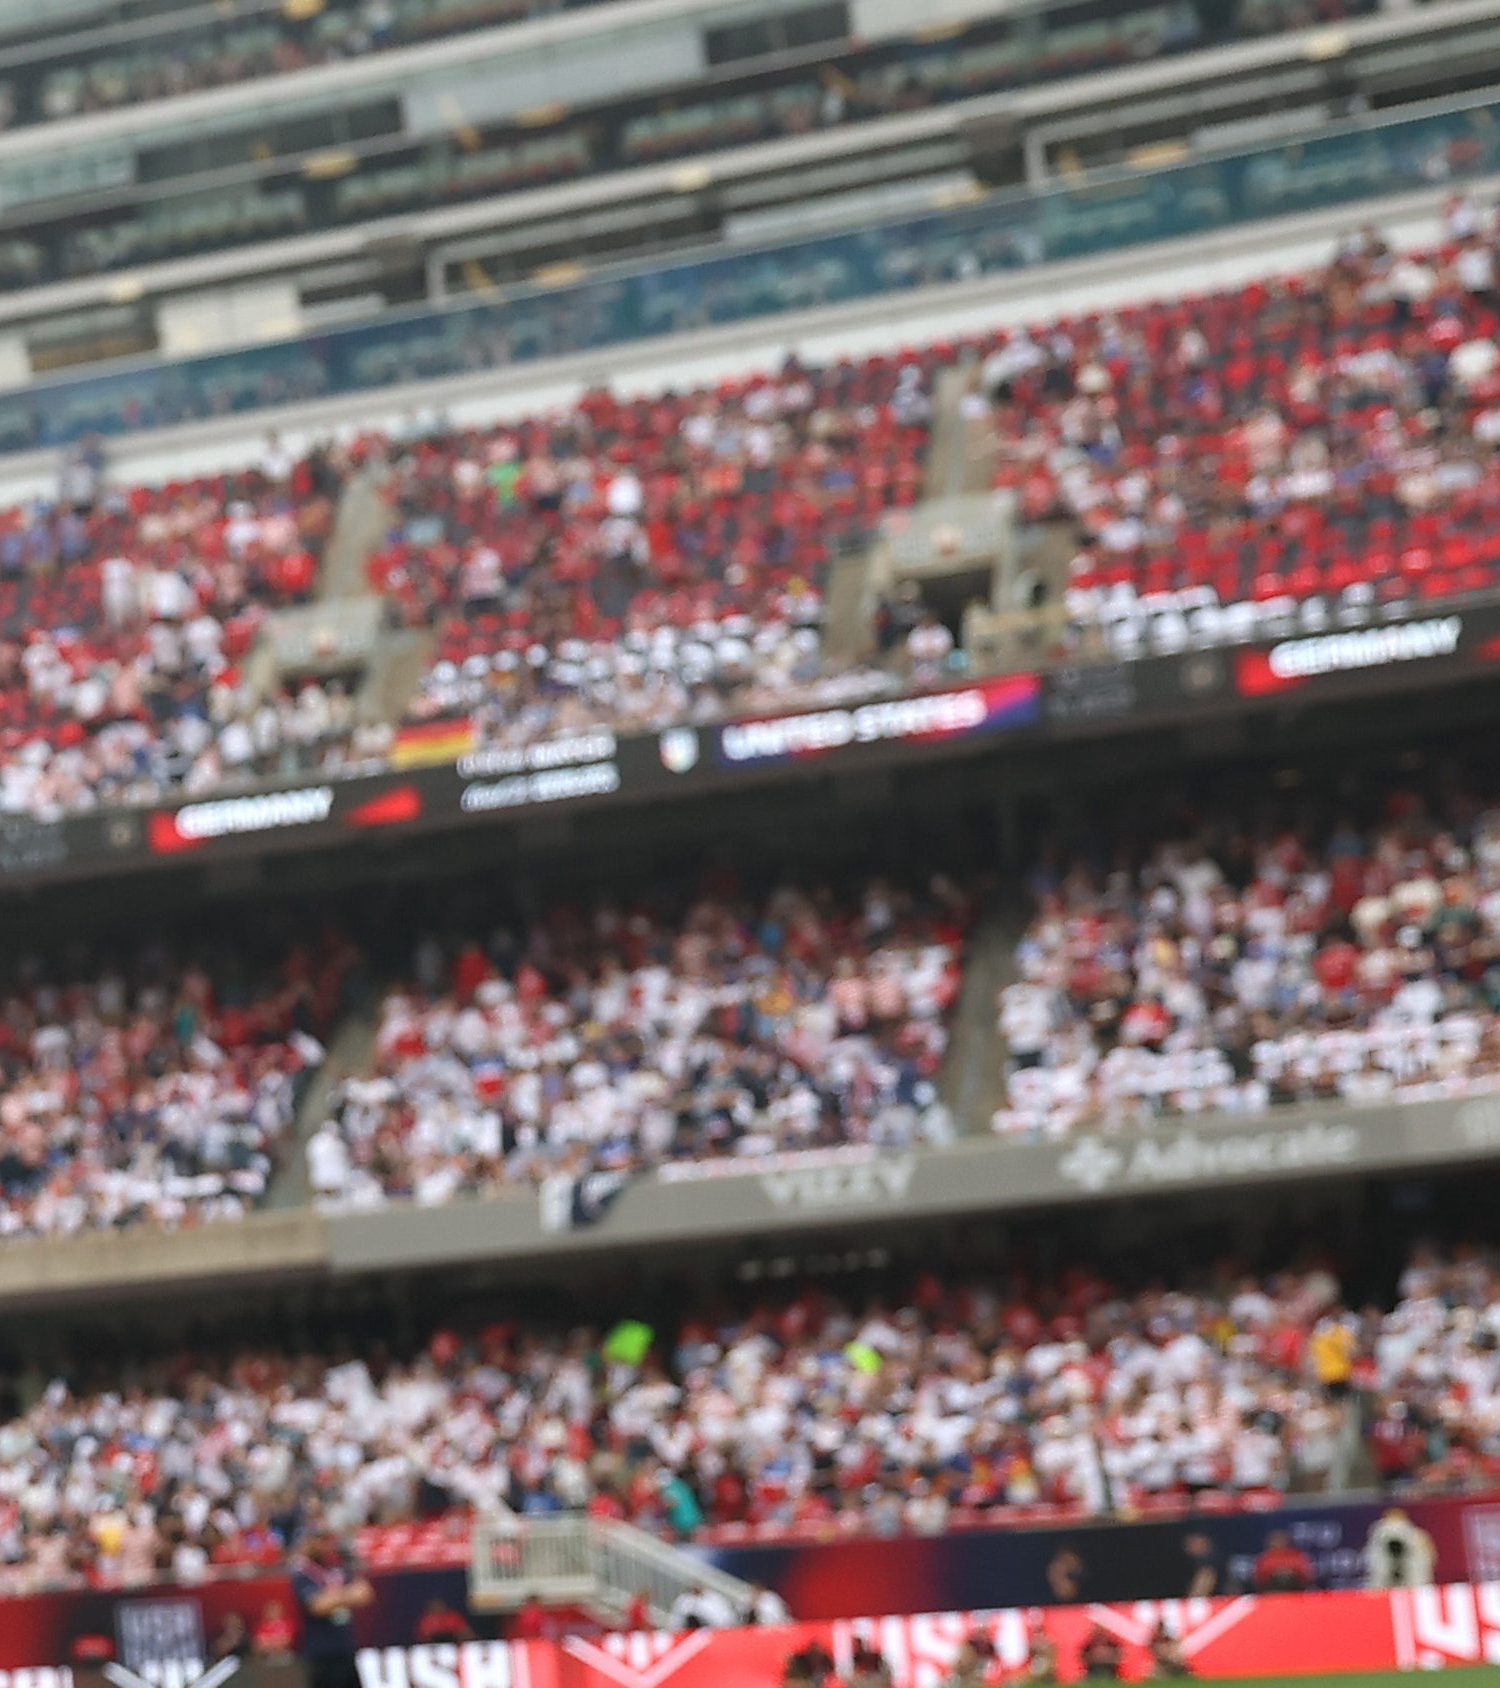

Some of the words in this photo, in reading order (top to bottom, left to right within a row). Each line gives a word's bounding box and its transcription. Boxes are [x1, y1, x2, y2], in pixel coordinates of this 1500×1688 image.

[1268, 615, 1463, 679] GERMANY
[722, 709, 854, 760] UNITED
[851, 689, 987, 742] STATES
[175, 785, 334, 839] GERMANY
[1129, 1123, 1360, 1186] Advocate
